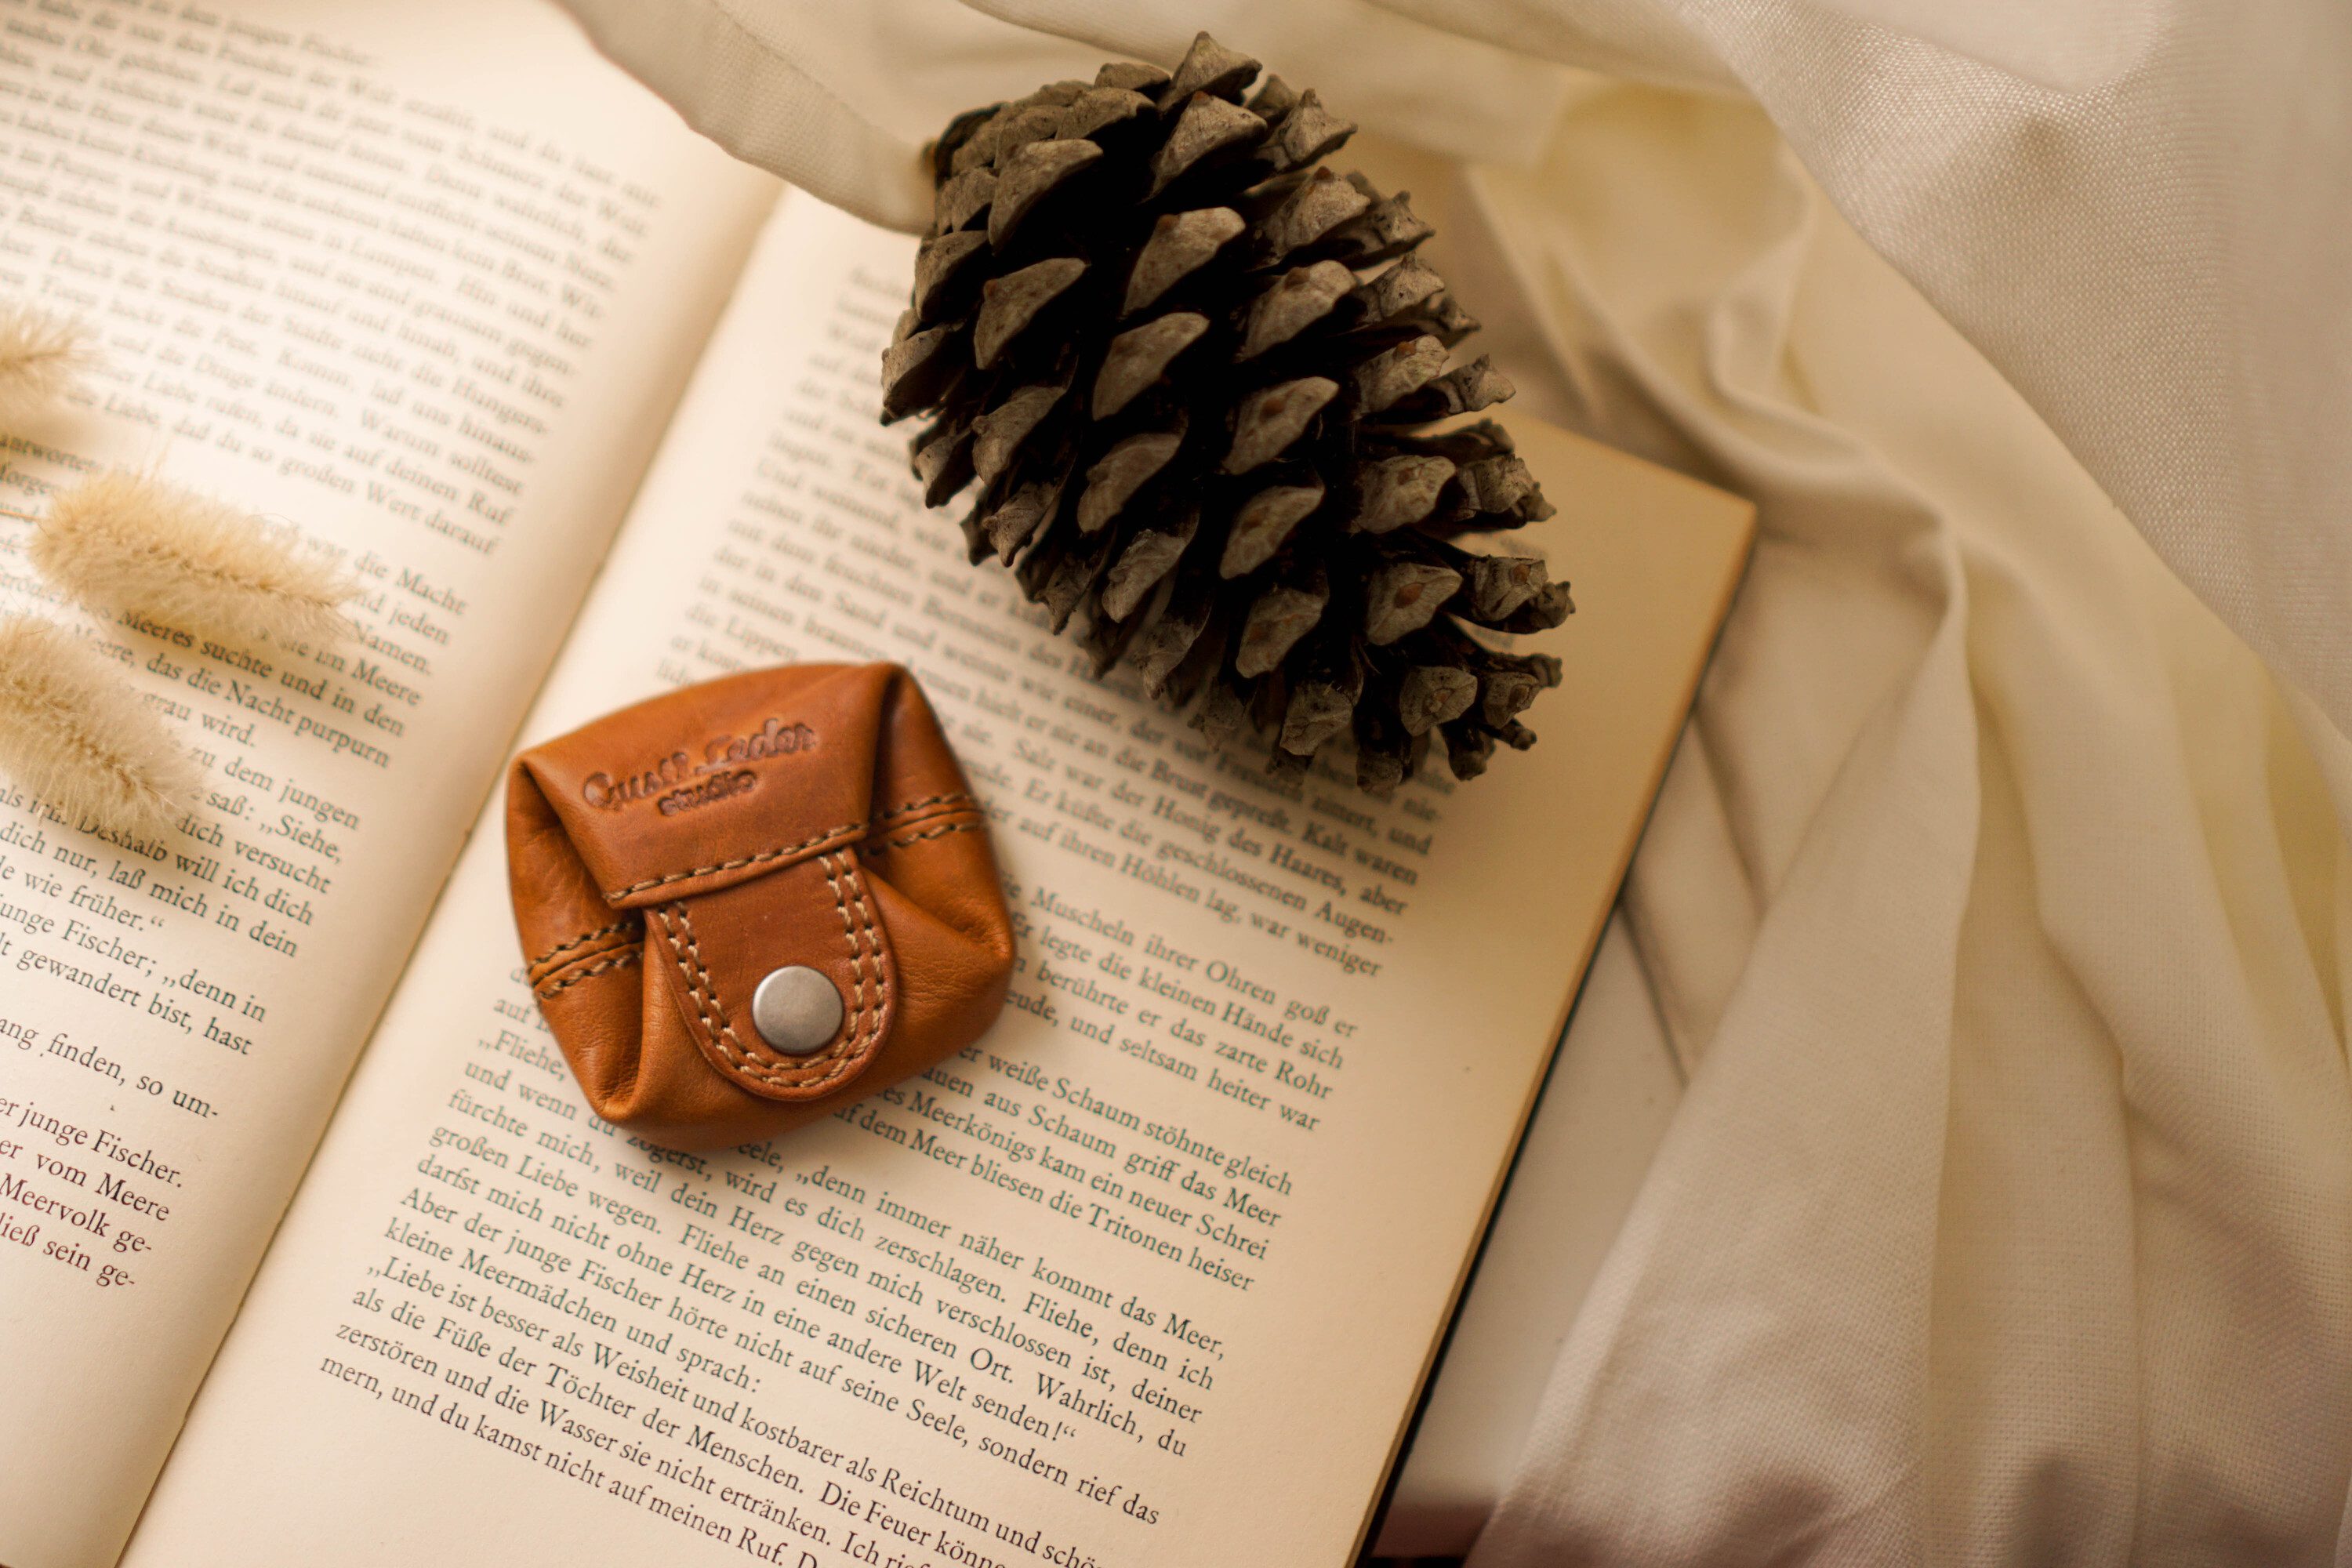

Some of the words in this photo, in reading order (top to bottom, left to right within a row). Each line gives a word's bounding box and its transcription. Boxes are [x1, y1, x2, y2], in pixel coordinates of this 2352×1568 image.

[146, 652, 183, 681] das
[187, 666, 222, 695] die
[224, 679, 296, 724] Nacht
[294, 716, 390, 768] purpurn
[199, 641, 274, 679] suchte
[280, 671, 328, 701] und
[331, 687, 355, 714] in
[363, 703, 404, 737] den
[202, 714, 255, 747] wird.
[205, 793, 254, 821] saß:
[224, 757, 273, 792] dem
[278, 779, 359, 830] jungen
[0, 821, 46, 855] dich
[53, 846, 97, 878] nur,
[107, 859, 147, 890] laß
[147, 883, 209, 918] mich
[215, 903, 240, 932] in
[248, 920, 298, 958] dein
[25, 873, 63, 898] wie
[175, 812, 224, 848] dich
[235, 840, 332, 895] versucht
[176, 854, 220, 884] will
[221, 868, 260, 902] ich
[263, 887, 313, 926] dich
[16, 949, 142, 1007] gewandert
[147, 992, 193, 1035] bist,
[202, 1016, 253, 1056] hast
[60, 919, 157, 978] Fischer;
[240, 994, 266, 1023] in
[1039, 925, 1092, 964] legte
[1098, 952, 1132, 981] die
[1138, 966, 1217, 1017] kleinen
[1220, 1000, 1294, 1049] Hände
[1298, 1038, 1344, 1071] sich
[47, 1033, 125, 1087] finden,
[136, 1076, 164, 1096] so
[172, 1090, 219, 1119] um-
[988, 1054, 1049, 1091] weiße
[1051, 1077, 1141, 1131] Schaum
[1143, 1122, 1225, 1167] stöhnte
[1223, 1156, 1292, 1196] gleich
[1069, 1016, 1116, 1046] und
[1118, 1038, 1198, 1082] seltsam
[1206, 1067, 1272, 1111] heiter
[1279, 1104, 1321, 1132] war
[16, 1101, 89, 1146] junge
[90, 1129, 182, 1189] Fischer.
[37, 1153, 87, 1188] vom
[93, 1171, 170, 1221] Meere
[858, 1109, 908, 1145] dem
[908, 1128, 968, 1170] Meer
[969, 1153, 1044, 1204] bliesen
[1048, 1189, 1083, 1219] die
[1087, 1203, 1183, 1263] Tritonen
[1186, 1246, 1255, 1291] heiser
[0, 1172, 111, 1238] Meervolk
[112, 1230, 152, 1254] ge-
[42, 1240, 91, 1272] sein
[96, 1264, 136, 1287] ge-
[383, 1217, 453, 1262] kleine
[458, 1247, 617, 1334] Meermädchen
[626, 1325, 673, 1356] und
[676, 1348, 760, 1393] sprach:
[417, 1153, 481, 1195] darfst
[485, 1188, 543, 1222] mich
[550, 1214, 611, 1250] nicht
[616, 1241, 673, 1277] ohne
[678, 1262, 737, 1304] Herz
[740, 1289, 765, 1317] in
[773, 1307, 821, 1339] eine
[826, 1332, 902, 1374] andere
[915, 1359, 967, 1402] Welt
[429, 1127, 509, 1169] großen
[515, 1154, 579, 1198] Liebe
[589, 1191, 662, 1235] wegen.
[678, 1223, 750, 1270] Fliehe
[757, 1264, 786, 1287] an
[796, 1277, 856, 1316] einen
[865, 1306, 958, 1359] sicheren
[969, 1347, 1014, 1385] Ort.
[1037, 1371, 1144, 1444] Wahrlich,
[1157, 1428, 1187, 1457] du
[875, 1191, 952, 1240] immer
[958, 1233, 1025, 1270] näher
[1031, 1257, 1114, 1309] kommt
[1120, 1295, 1157, 1327] das
[1161, 1312, 1224, 1361] Meer,
[400, 1187, 459, 1224] Aber
[463, 1212, 503, 1243] der
[503, 1229, 572, 1273] junge
[577, 1258, 663, 1311] Fischer
[666, 1296, 728, 1339] hörte
[734, 1331, 794, 1368] nicht
[798, 1360, 844, 1386] auf
[840, 1377, 899, 1412] seine
[906, 1398, 968, 1448] Seele,
[978, 1436, 1069, 1487] sondern
[1075, 1475, 1123, 1507] rief
[1122, 1493, 1160, 1525] das
[319, 1357, 383, 1400] mern,
[391, 1386, 440, 1417] und
[439, 1401, 470, 1432] du
[472, 1414, 543, 1461] kamst
[543, 1451, 606, 1489] nicht
[608, 1480, 654, 1506] auf
[647, 1497, 732, 1544] meinen
[735, 1526, 789, 1567] Ruf.
[336, 1324, 438, 1377] zerstören
[444, 1368, 493, 1399] und
[494, 1384, 530, 1415] die
[540, 1399, 619, 1453] Wasser
[619, 1440, 652, 1468] sie
[655, 1458, 717, 1495] nicht
[720, 1486, 831, 1546] ertränken.
[840, 1530, 880, 1567] Ich
[352, 1287, 384, 1312] als
[390, 1301, 426, 1330] die
[432, 1316, 492, 1358] Füße
[497, 1345, 538, 1377] der
[545, 1362, 637, 1420] Töchter
[641, 1406, 681, 1439] der
[684, 1424, 804, 1494] Menschen.
[818, 1480, 862, 1517] Die
[862, 1499, 932, 1547] Feuer
[447, 1283, 478, 1312] ist
[479, 1295, 550, 1342] besser
[551, 1331, 584, 1357] als
[593, 1341, 690, 1403] Weisheit
[691, 1393, 740, 1425] und
[739, 1406, 845, 1468] kostbarer
[845, 1457, 877, 1483] als
[878, 1467, 990, 1534] Reichtum
[995, 1523, 1043, 1555] und
